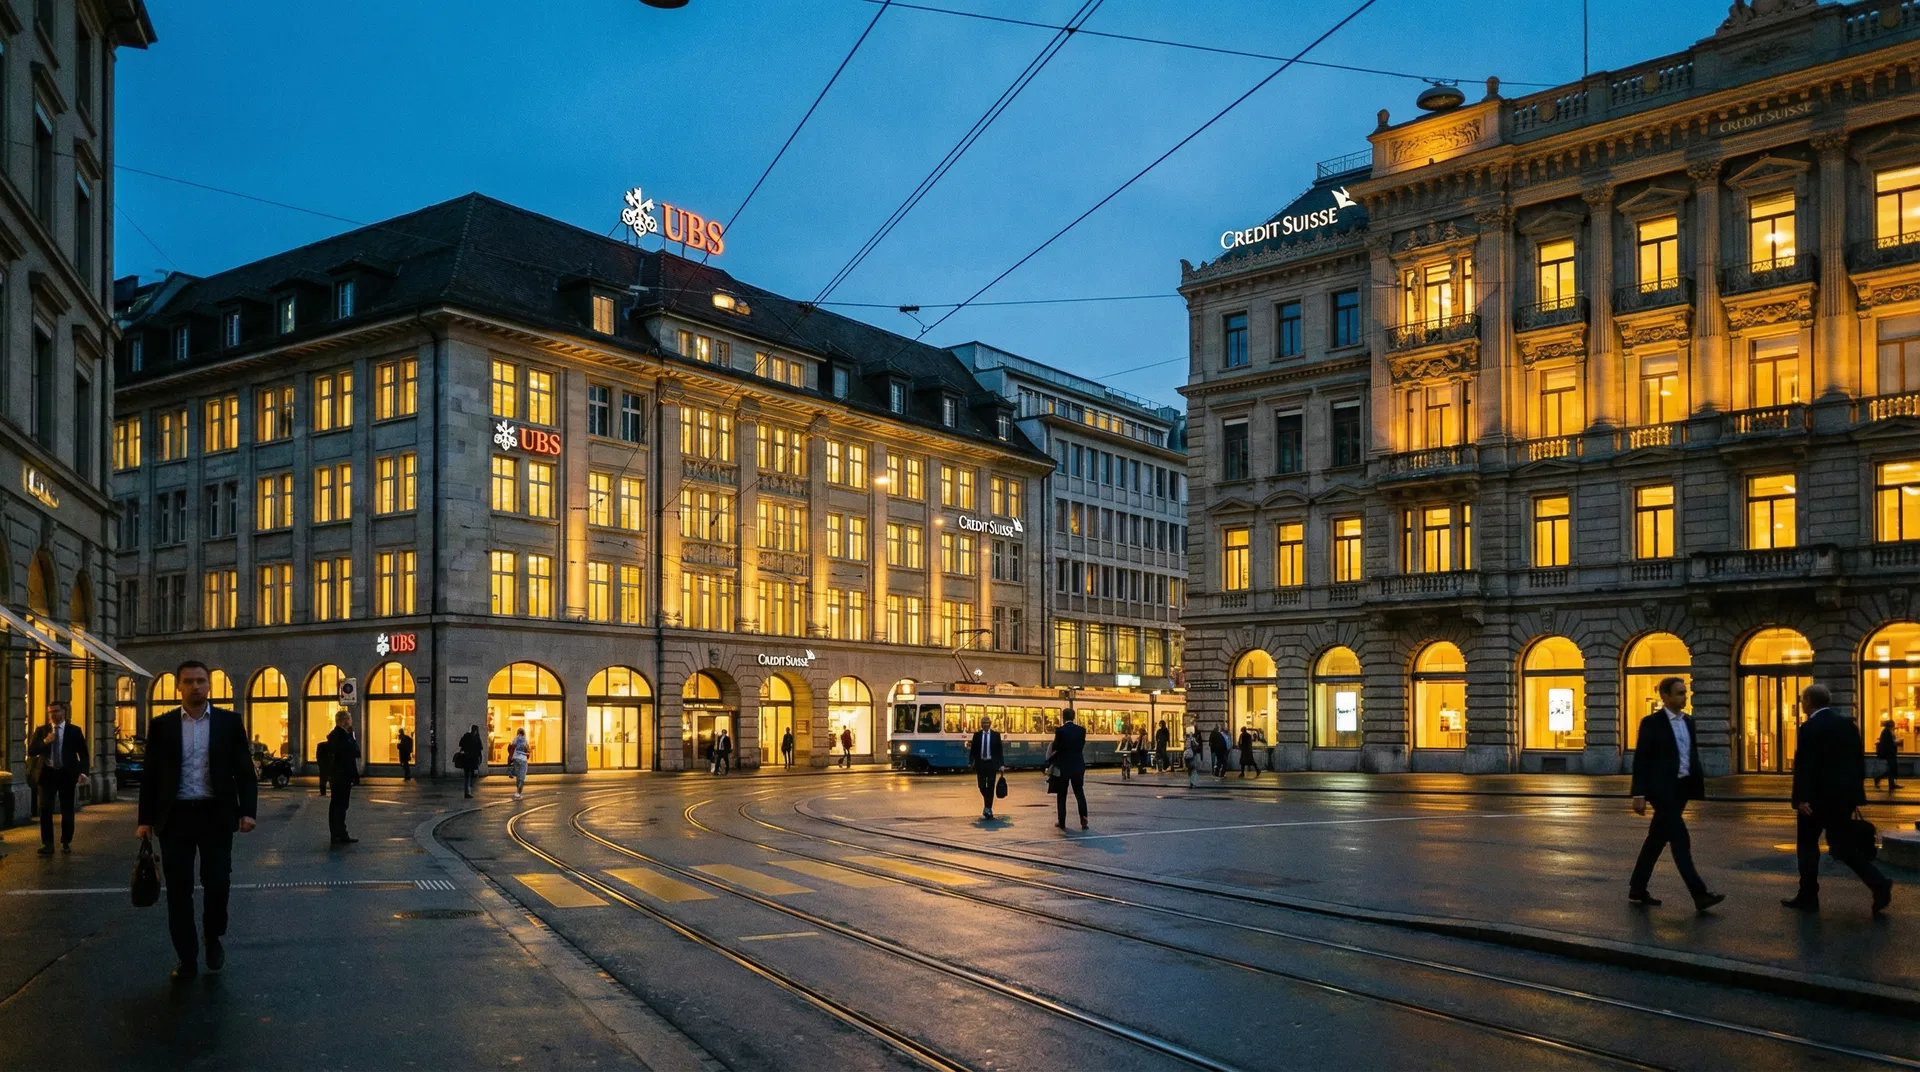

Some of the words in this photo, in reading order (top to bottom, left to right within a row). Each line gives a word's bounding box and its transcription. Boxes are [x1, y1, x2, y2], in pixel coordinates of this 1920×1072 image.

[1719, 114, 1763, 133] CREDIT
[1767, 102, 1813, 122] SUISSE
[661, 202, 725, 256] UBS
[1220, 221, 1281, 250] CREDIT
[1282, 207, 1339, 236] SUISSE
[519, 427, 561, 455] UBS
[958, 515, 989, 533] CREDIT
[390, 634, 416, 652] UBS
